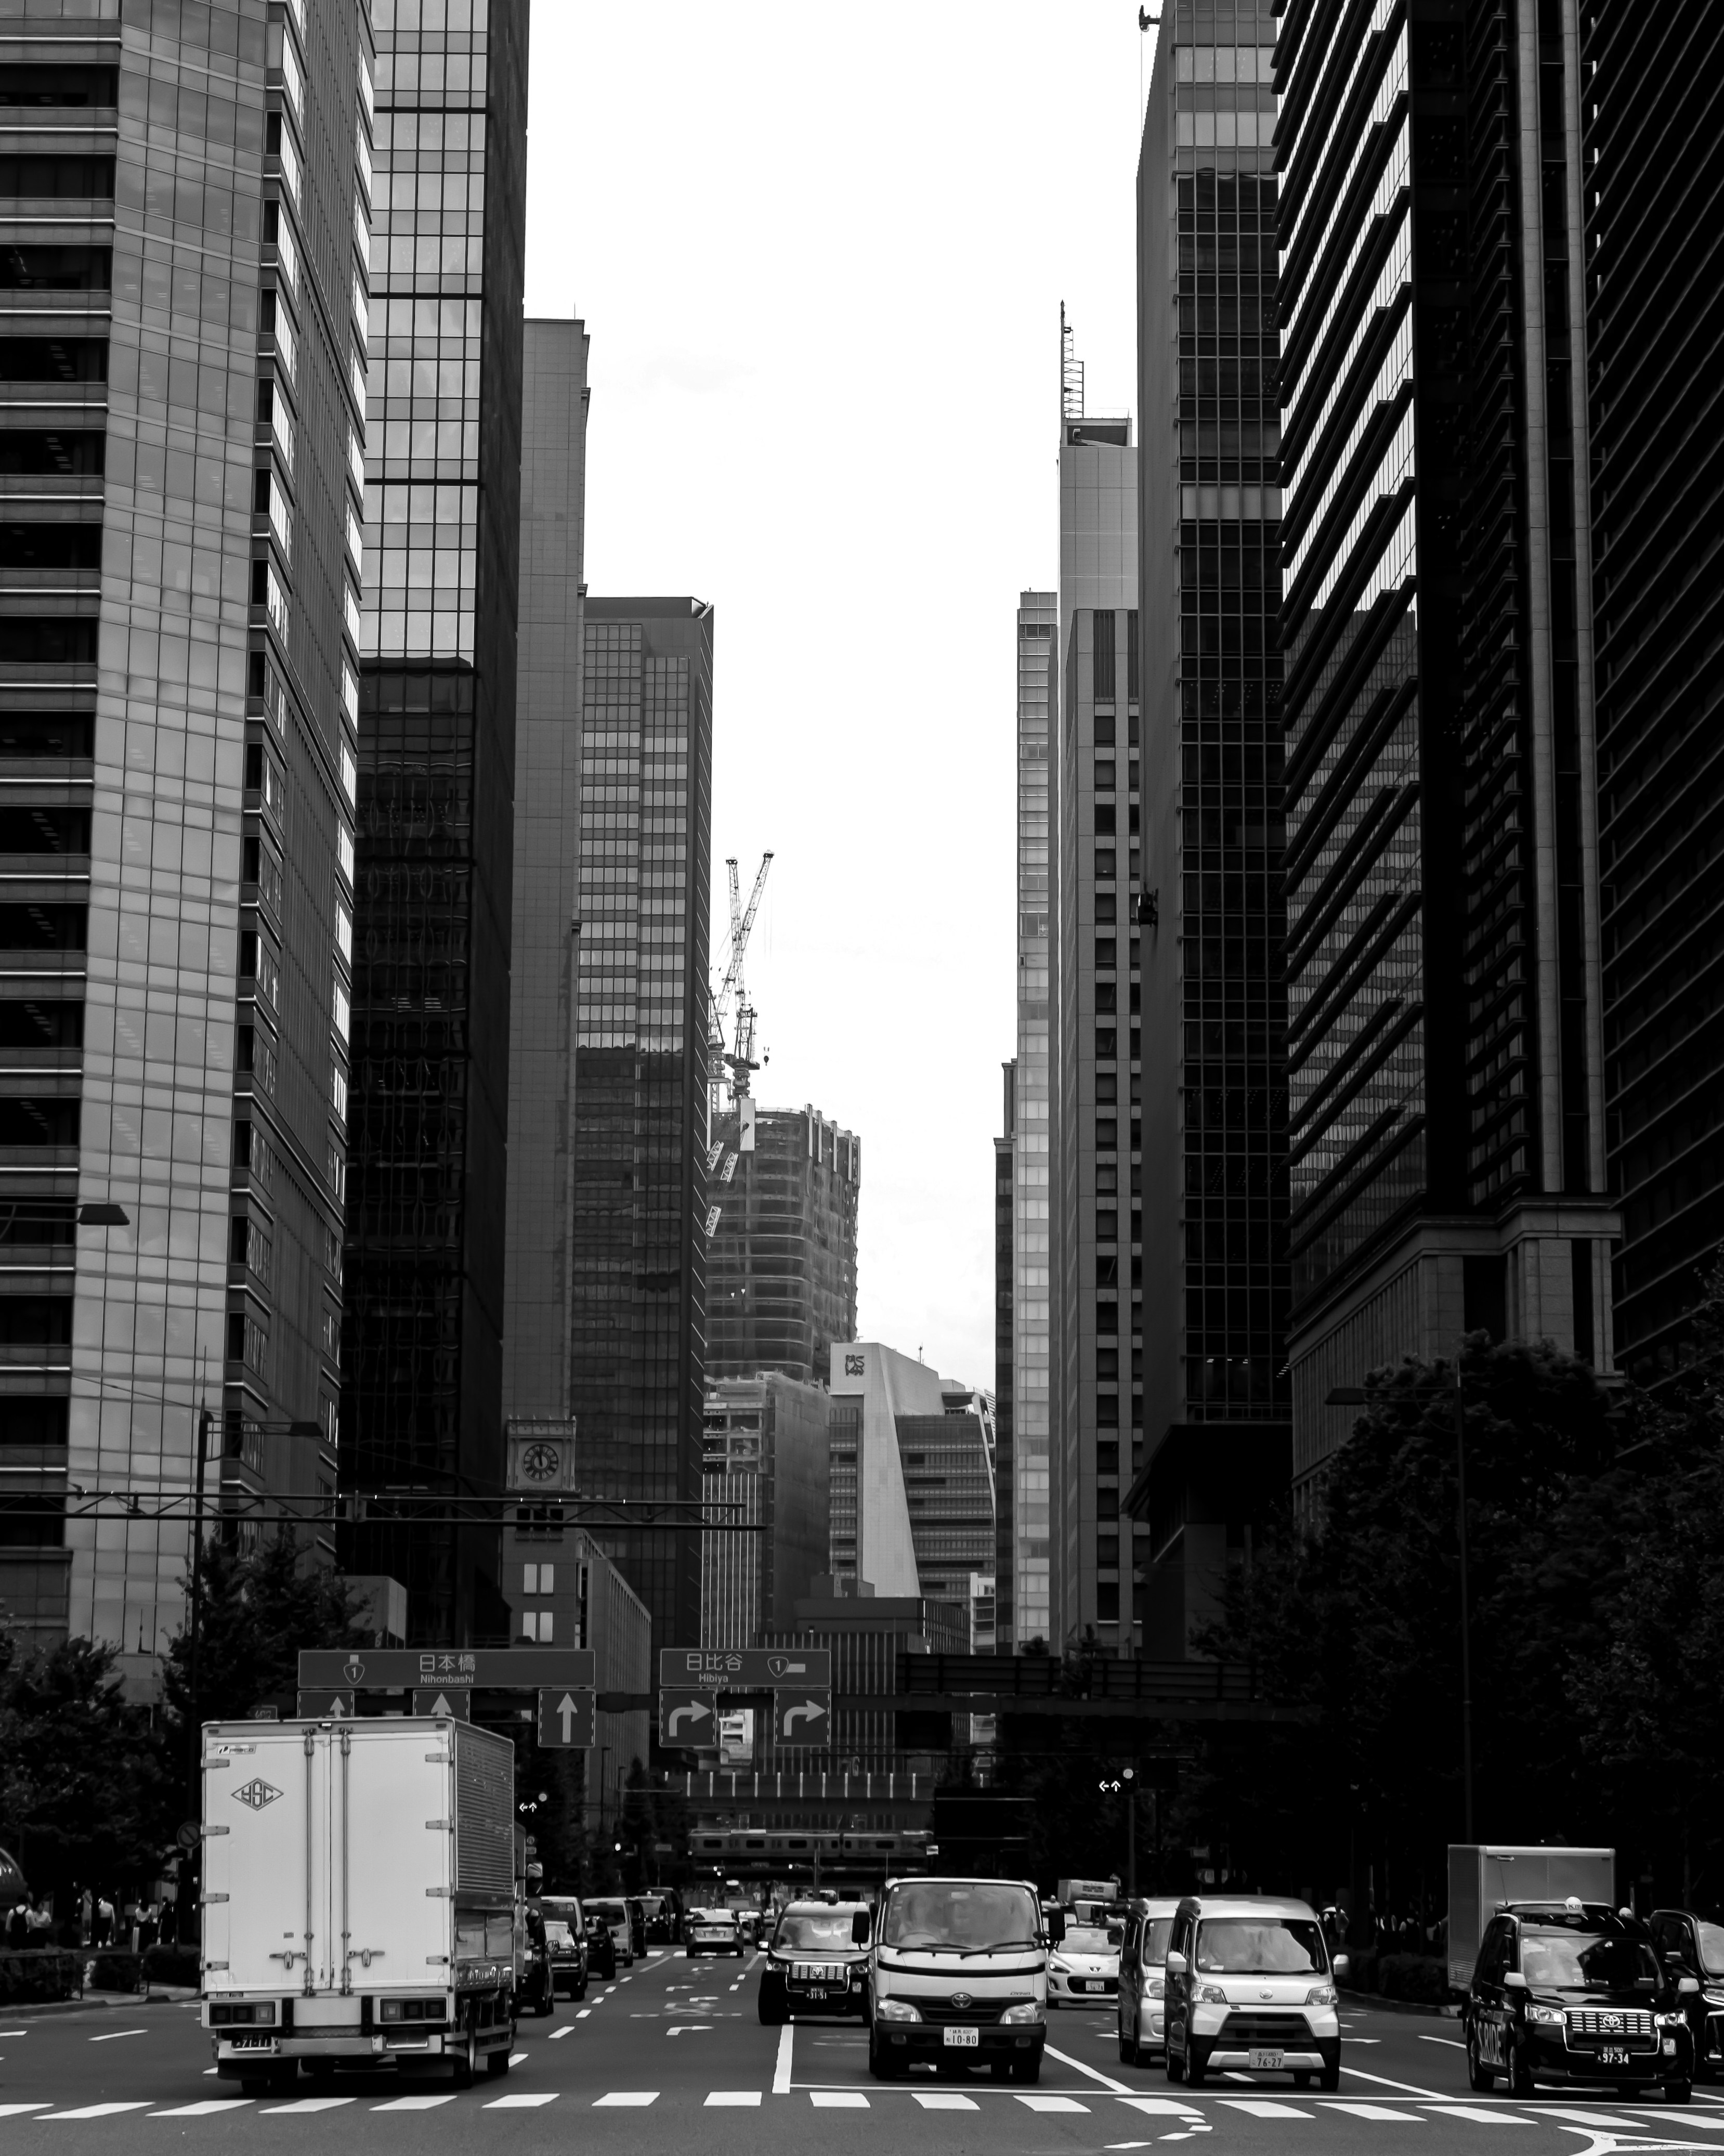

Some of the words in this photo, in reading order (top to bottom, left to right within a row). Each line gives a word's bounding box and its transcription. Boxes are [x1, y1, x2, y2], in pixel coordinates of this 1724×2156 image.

[420, 1654, 475, 1672] 日本橋
[686, 1653, 743, 1671] 日比谷
[420, 1674, 474, 1684] Nihonbashi
[699, 1673, 729, 1685] Hibiya
[953, 2035, 976, 2044] 10-80
[1257, 2058, 1282, 2067] 76-27
[1602, 2053, 1629, 2064] 97-34
